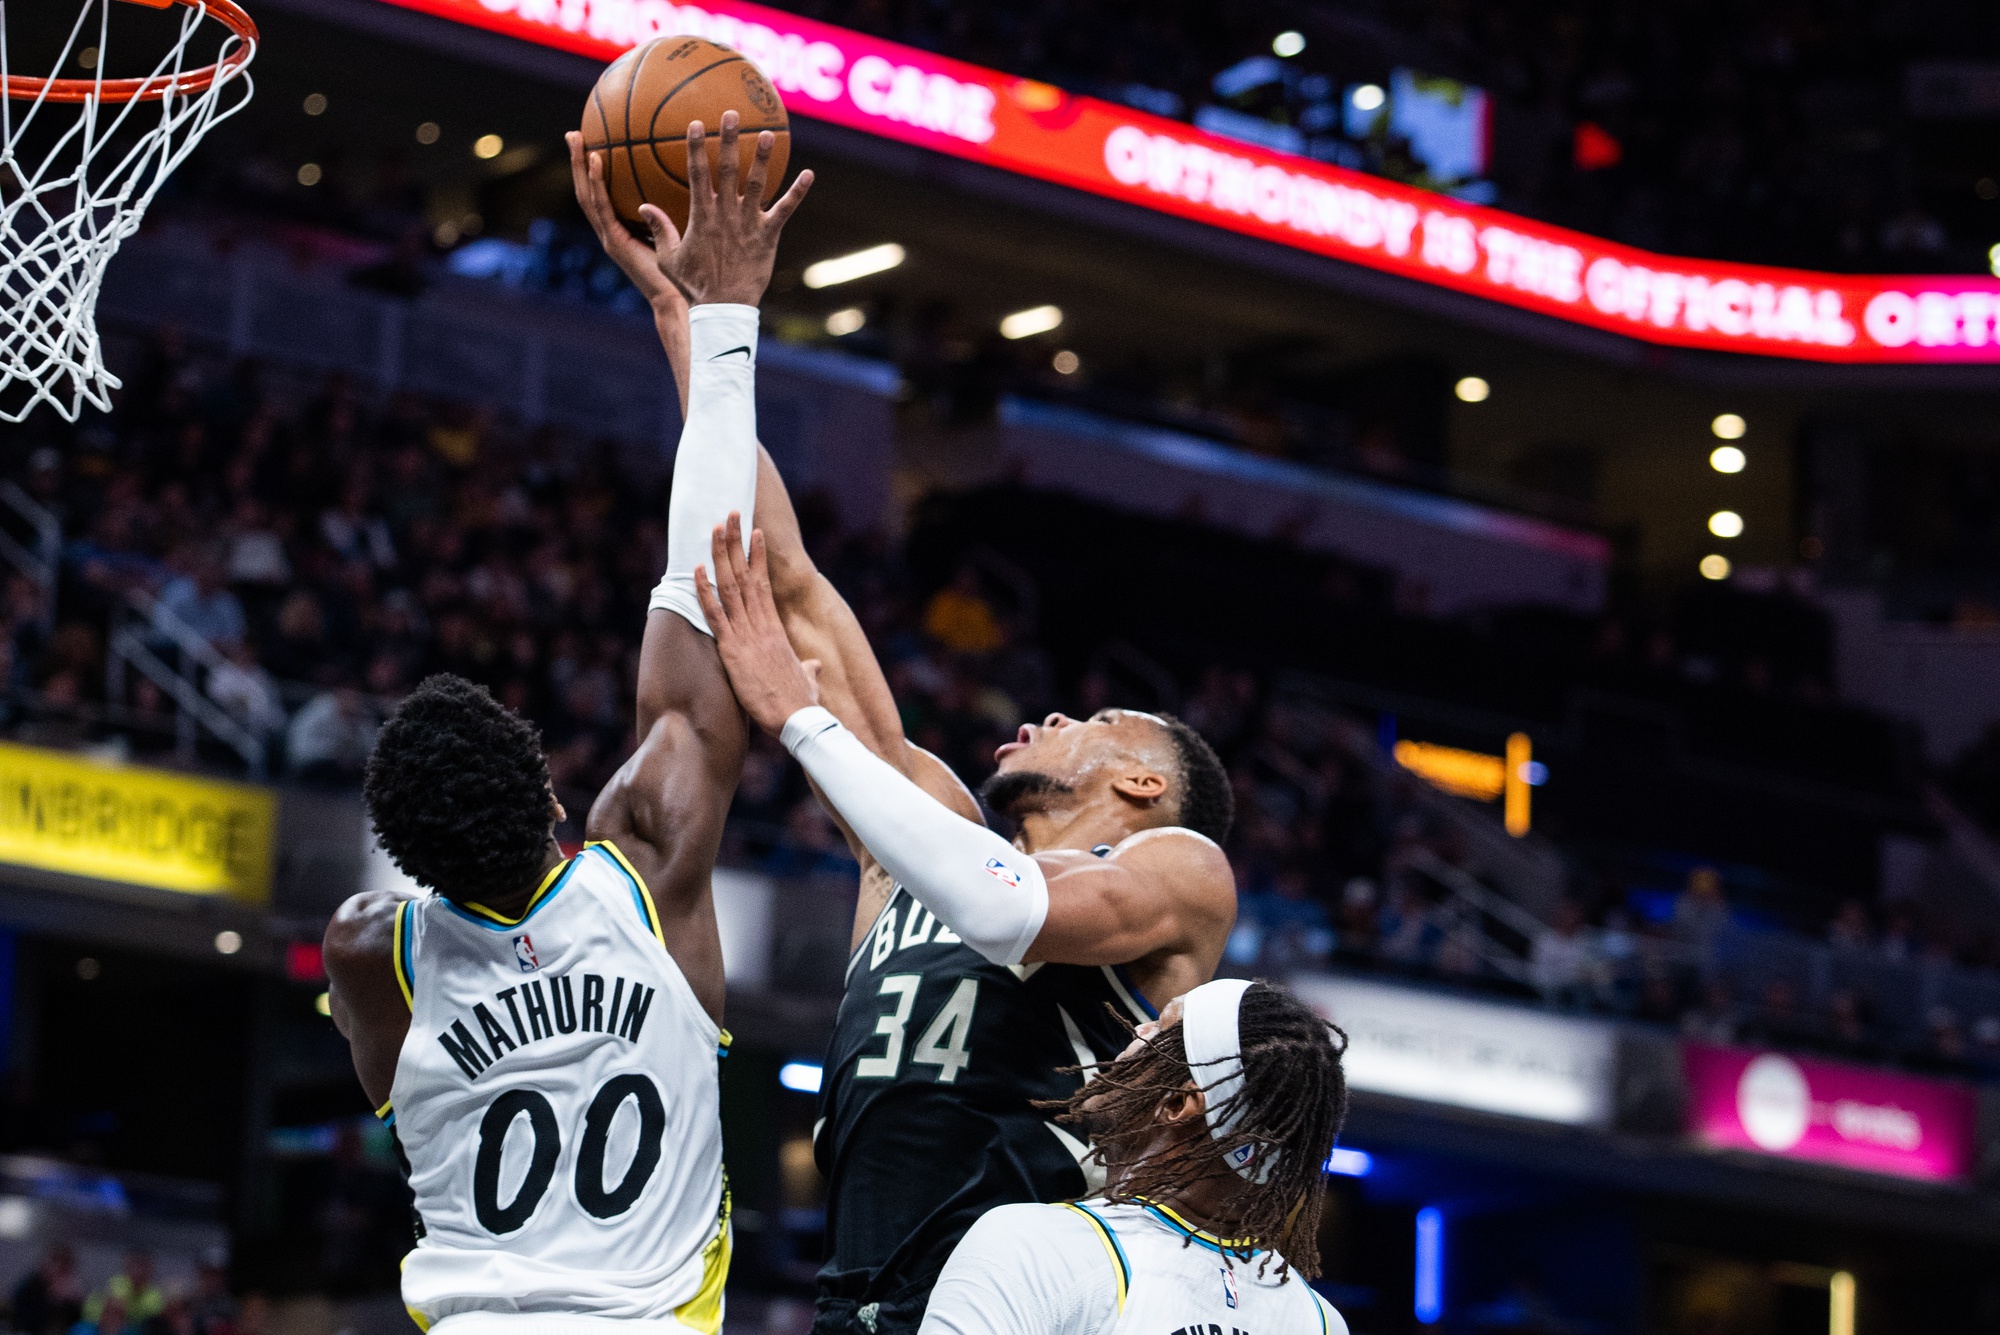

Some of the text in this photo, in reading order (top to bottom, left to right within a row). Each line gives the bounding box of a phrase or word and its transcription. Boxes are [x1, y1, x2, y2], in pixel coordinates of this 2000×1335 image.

[847, 55, 995, 145] CARE
[1105, 126, 2000, 348] ORTHOINDY IS THE OFFICIAL ORT
[437, 974, 655, 1081] MATHURIN
[855, 972, 981, 1084] 34
[473, 1073, 665, 1236] 00
